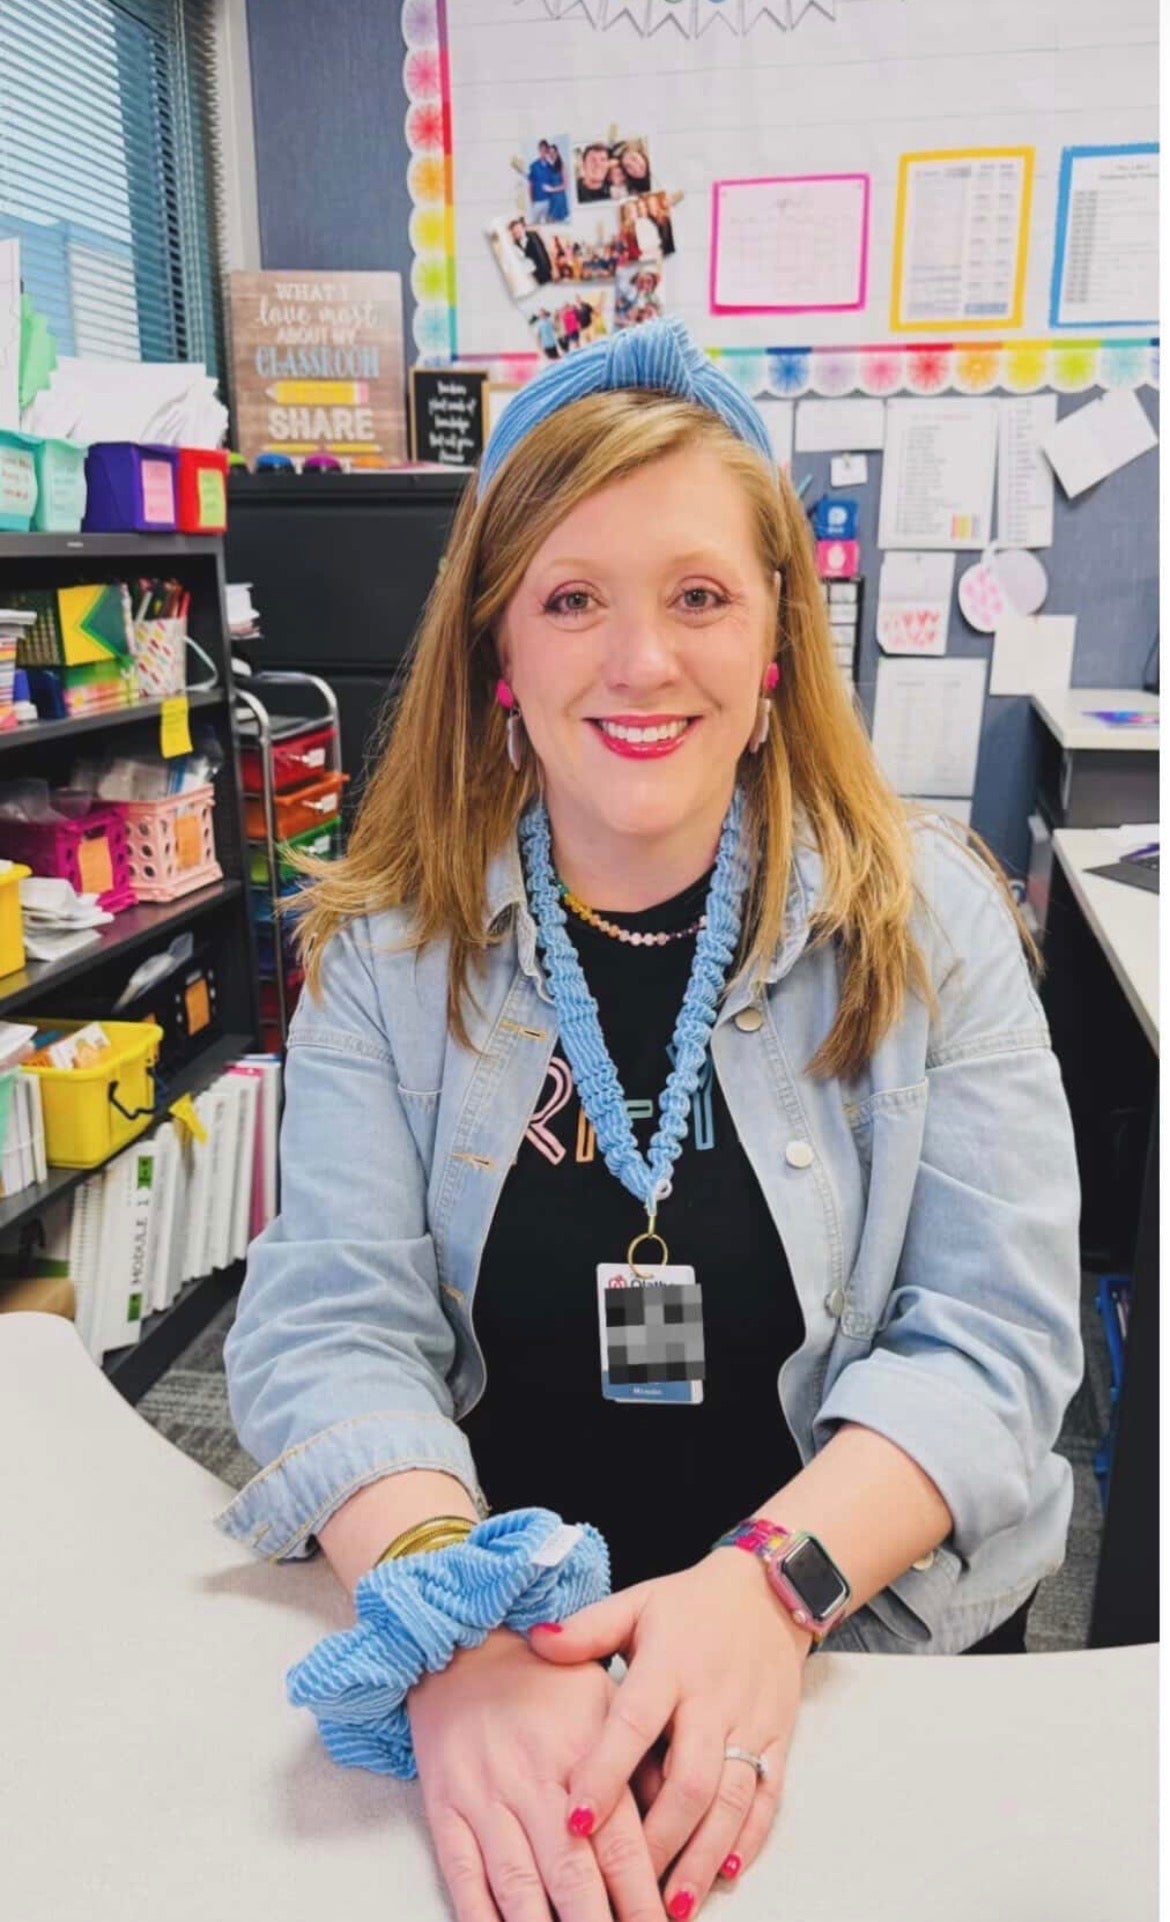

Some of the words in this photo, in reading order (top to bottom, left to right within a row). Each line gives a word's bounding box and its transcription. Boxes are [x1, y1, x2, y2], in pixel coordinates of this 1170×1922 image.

[275, 283, 336, 301] WHAT
[258, 293, 312, 327] love
[319, 301, 379, 328] most
[255, 345, 381, 379] CLASSROOM
[267, 406, 376, 441] SHARE
[131, 1217, 148, 1285] MODULE
